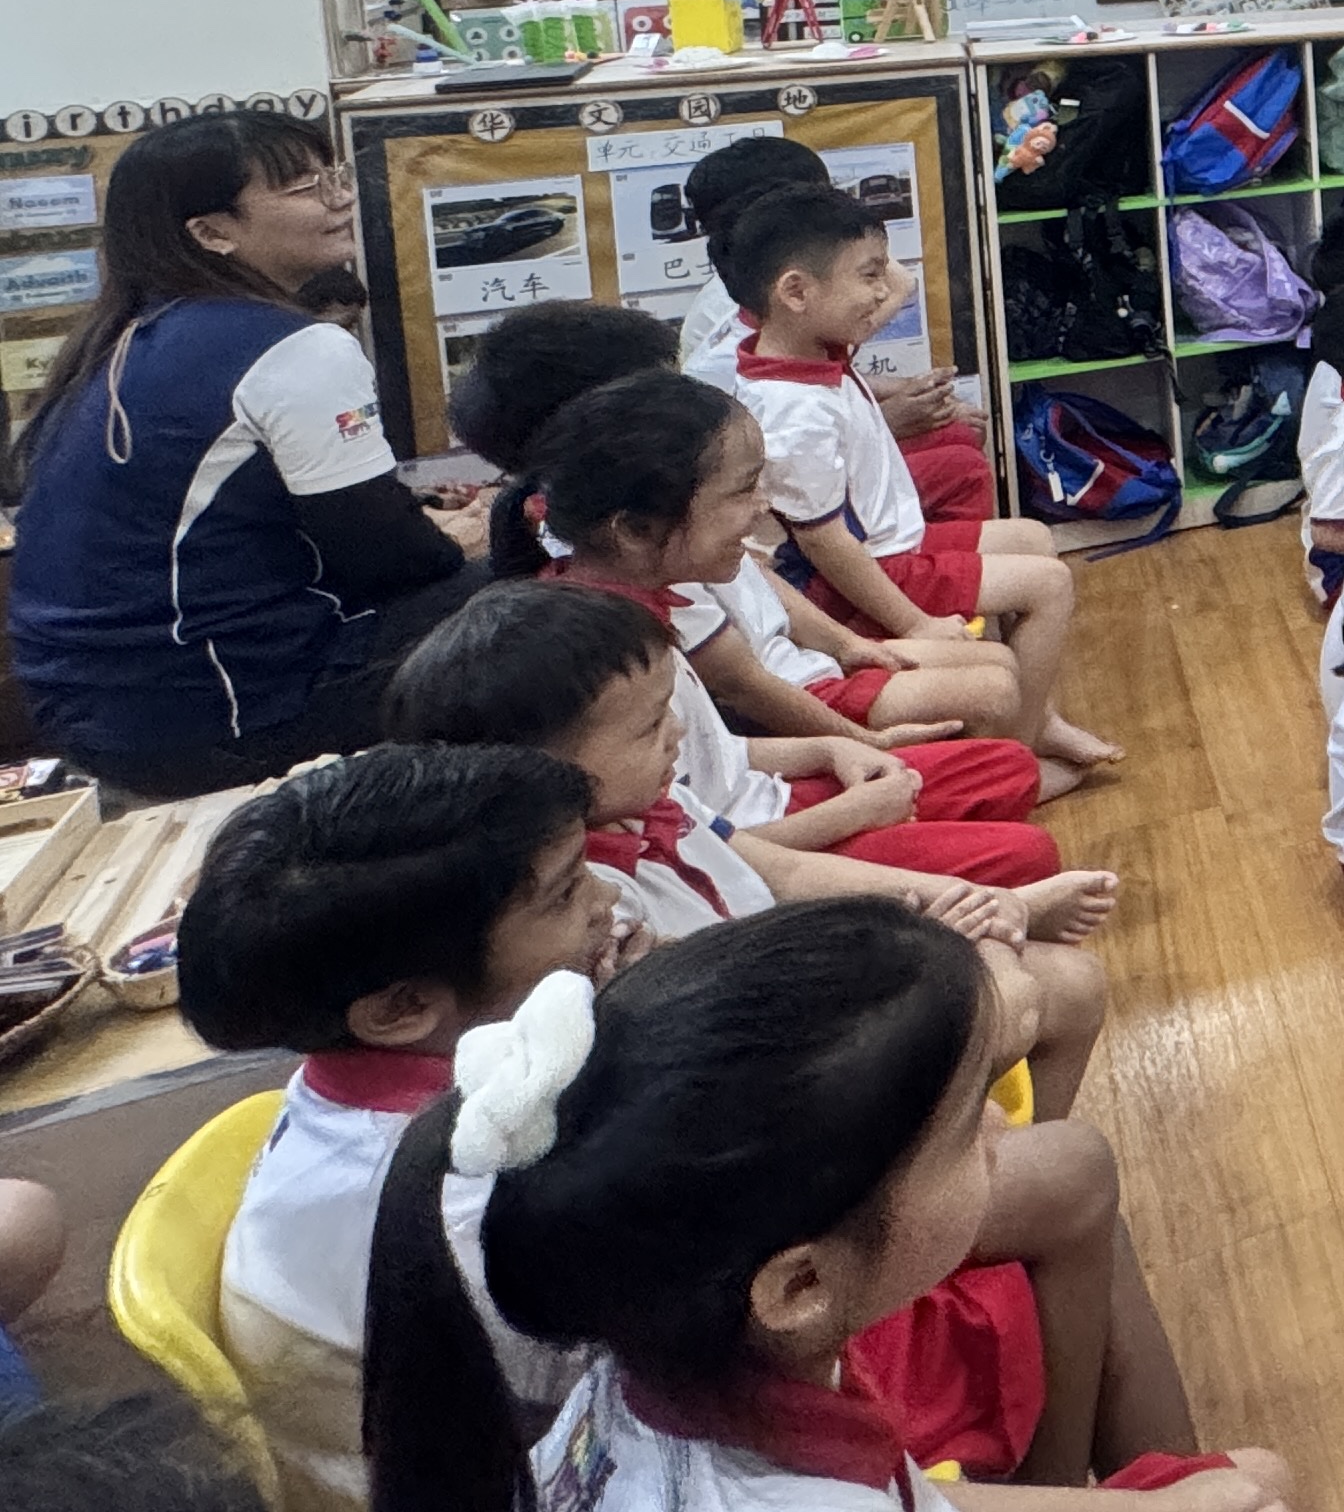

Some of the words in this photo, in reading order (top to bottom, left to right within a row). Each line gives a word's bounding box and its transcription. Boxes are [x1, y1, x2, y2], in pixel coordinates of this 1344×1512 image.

[477, 88, 809, 140] 华文园地
[481, 272, 549, 303] 汽车
